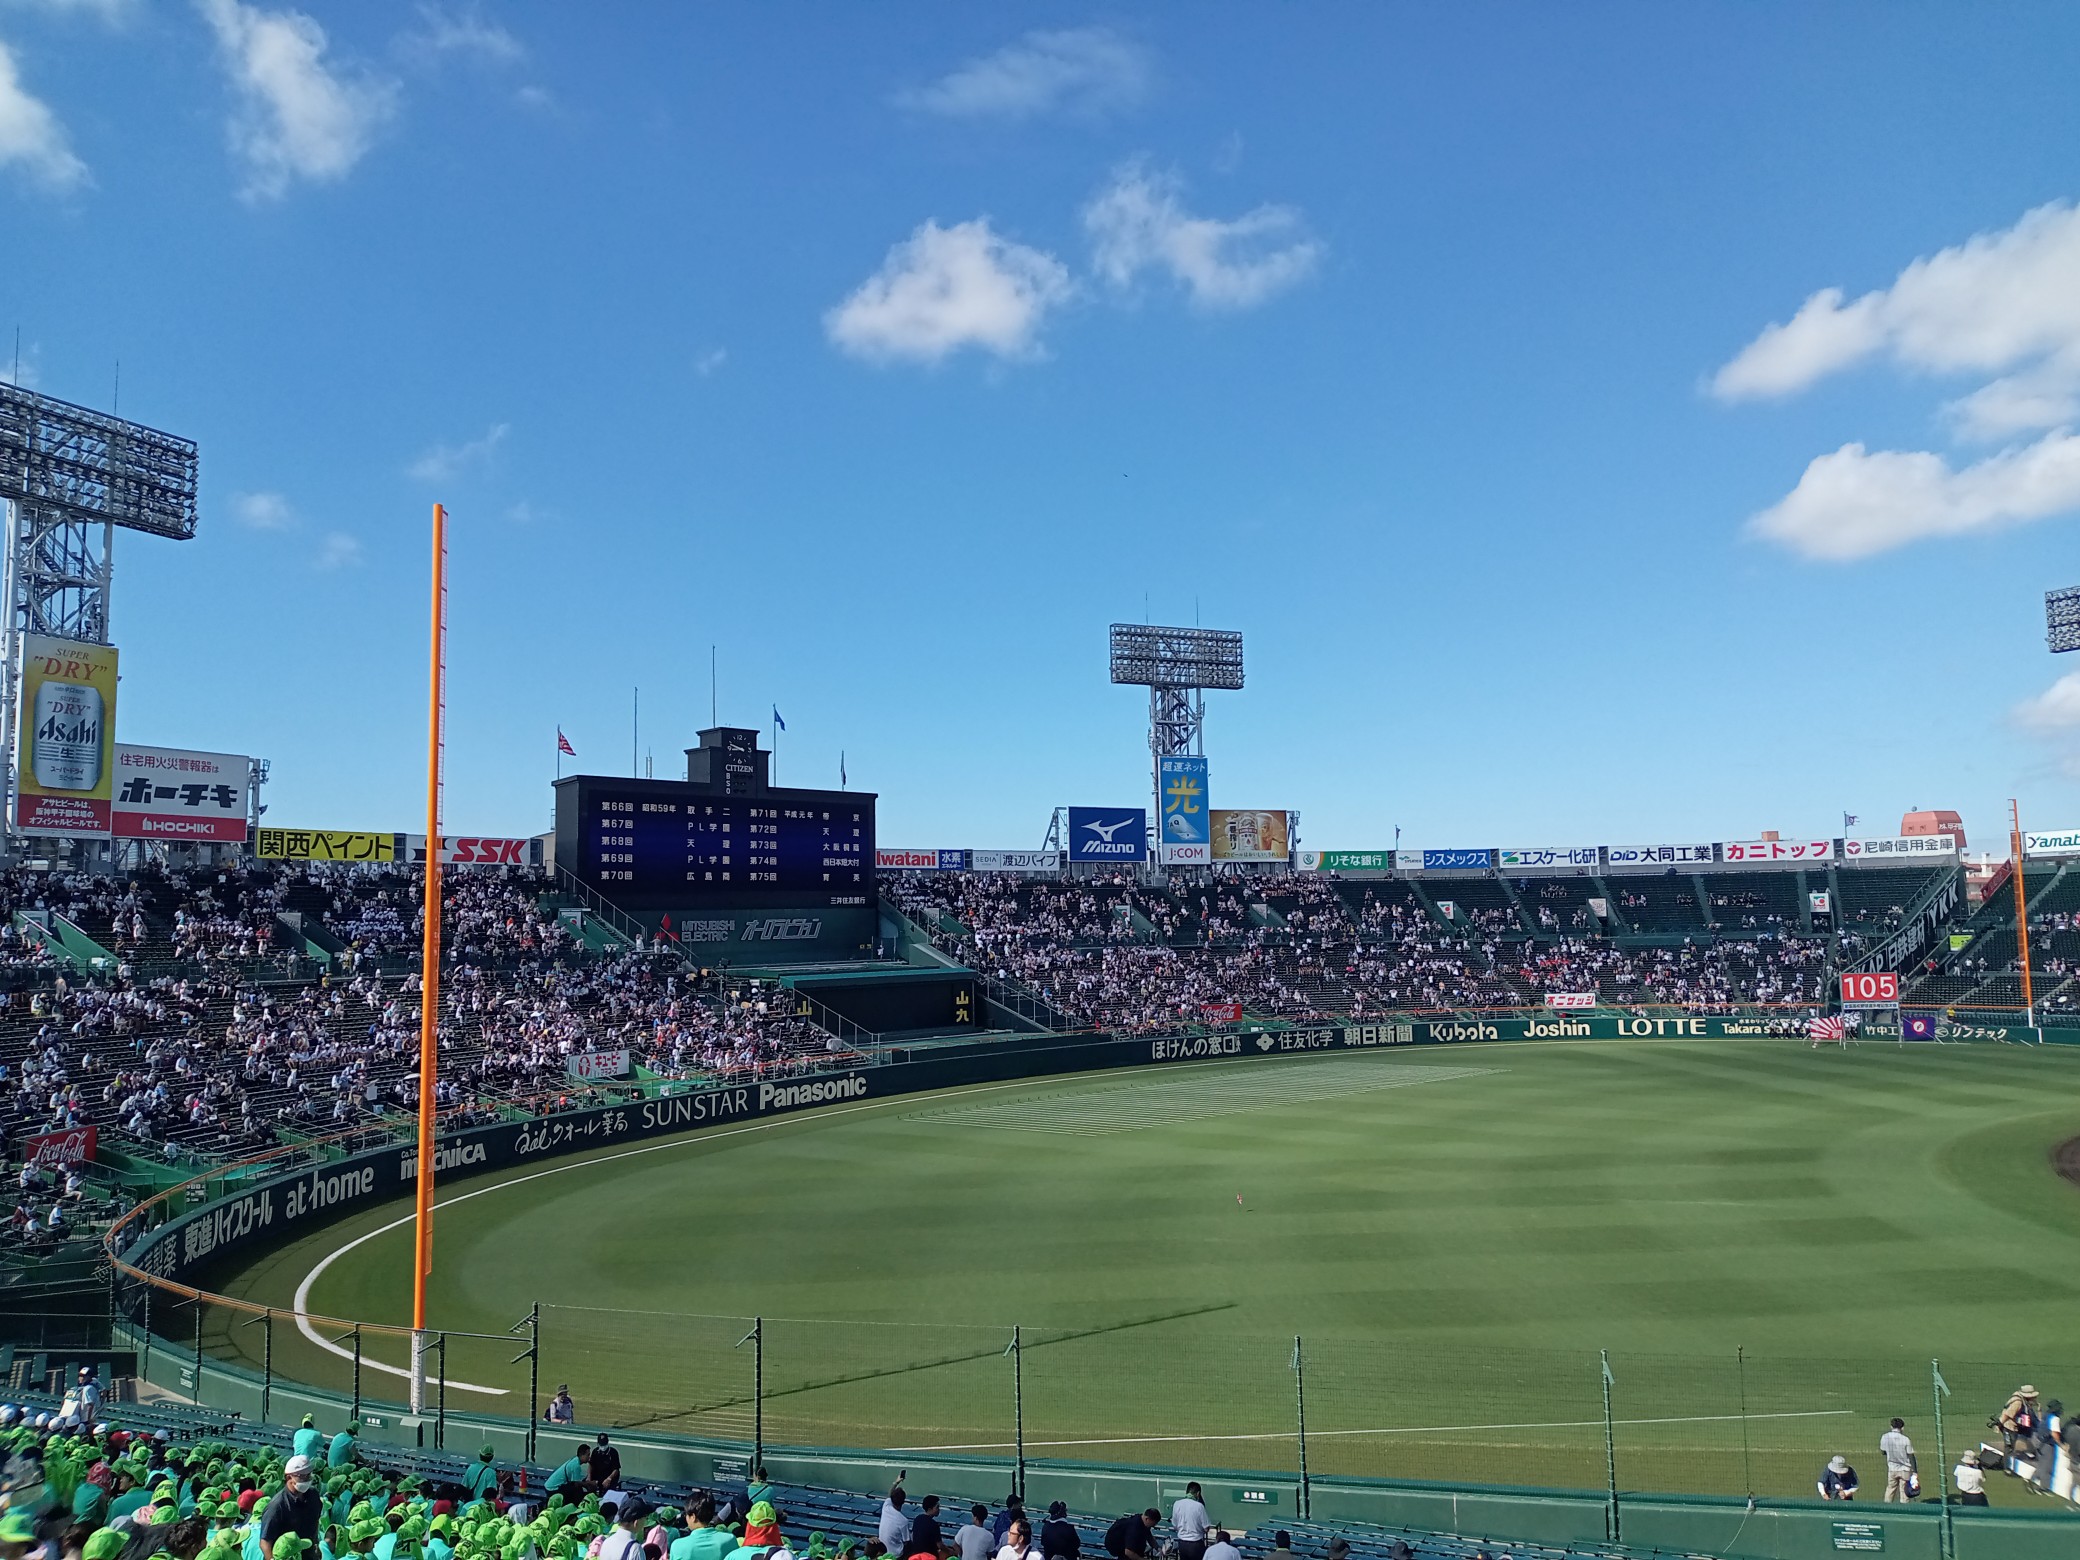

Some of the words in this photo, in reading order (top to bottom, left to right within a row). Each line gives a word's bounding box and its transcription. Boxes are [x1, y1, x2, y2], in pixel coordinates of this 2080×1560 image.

[56, 648, 89, 660] SUPER
[39, 715, 97, 745] Asahi
[61, 747, 74, 759] 生
[120, 753, 219, 773] 住宅用火災警報器は
[725, 764, 754, 773] CITIZEN
[118, 777, 238, 808] ホーチキ
[1165, 775, 1203, 814] 光
[36, 807, 94, 818] 阪神甲子園球場の
[602, 802, 634, 812] 第66回
[642, 803, 677, 813] 昭和59年
[750, 809, 777, 818] 第71回
[784, 810, 814, 819] 平成元年
[152, 821, 215, 834] HOCHIKI
[602, 819, 633, 829] 第67回
[750, 825, 777, 834] 第72回
[259, 831, 392, 860] 関西ペイント
[602, 836, 633, 846] 第68回
[750, 841, 777, 850] 第73回
[1864, 838, 1955, 854] 尼崎信用金庫
[452, 839, 527, 863] SSK
[1169, 847, 1203, 860] J:COM
[1640, 847, 1712, 862] 大同工業
[1727, 840, 1830, 860] カニトップ
[601, 854, 633, 863] 第69回
[750, 857, 777, 866] 第74回
[876, 851, 936, 866] Iwatani
[941, 853, 961, 863] 水素
[1002, 854, 1058, 867] 渡辺パイプ
[1330, 854, 1382, 867] りそな銀行
[1425, 852, 1488, 866] シスメックス
[1519, 849, 1596, 865] エスケー化研
[601, 871, 633, 881] 第70回
[750, 873, 777, 882] 第75回
[829, 897, 866, 905] 三井住友銀行
[1928, 881, 1959, 929] YKK
[682, 920, 736, 931] MITSUBISHI
[682, 931, 729, 942] ELECTRIC
[1843, 975, 1895, 998] 105
[1430, 1022, 1498, 1042] Kubota
[1523, 1019, 1591, 1037] Joshin
[1617, 1018, 1707, 1036] LOTTE
[1721, 1023, 1762, 1034] Takara
[1278, 1031, 1333, 1050] 住友化学
[1344, 1025, 1413, 1045] 朝日新聞
[1152, 1036, 1237, 1060] ほけんの窓口
[760, 1072, 867, 1110] Panasonic
[642, 1089, 749, 1129] SUNSTAR
[183, 1188, 273, 1266] 東進ハイスクール
